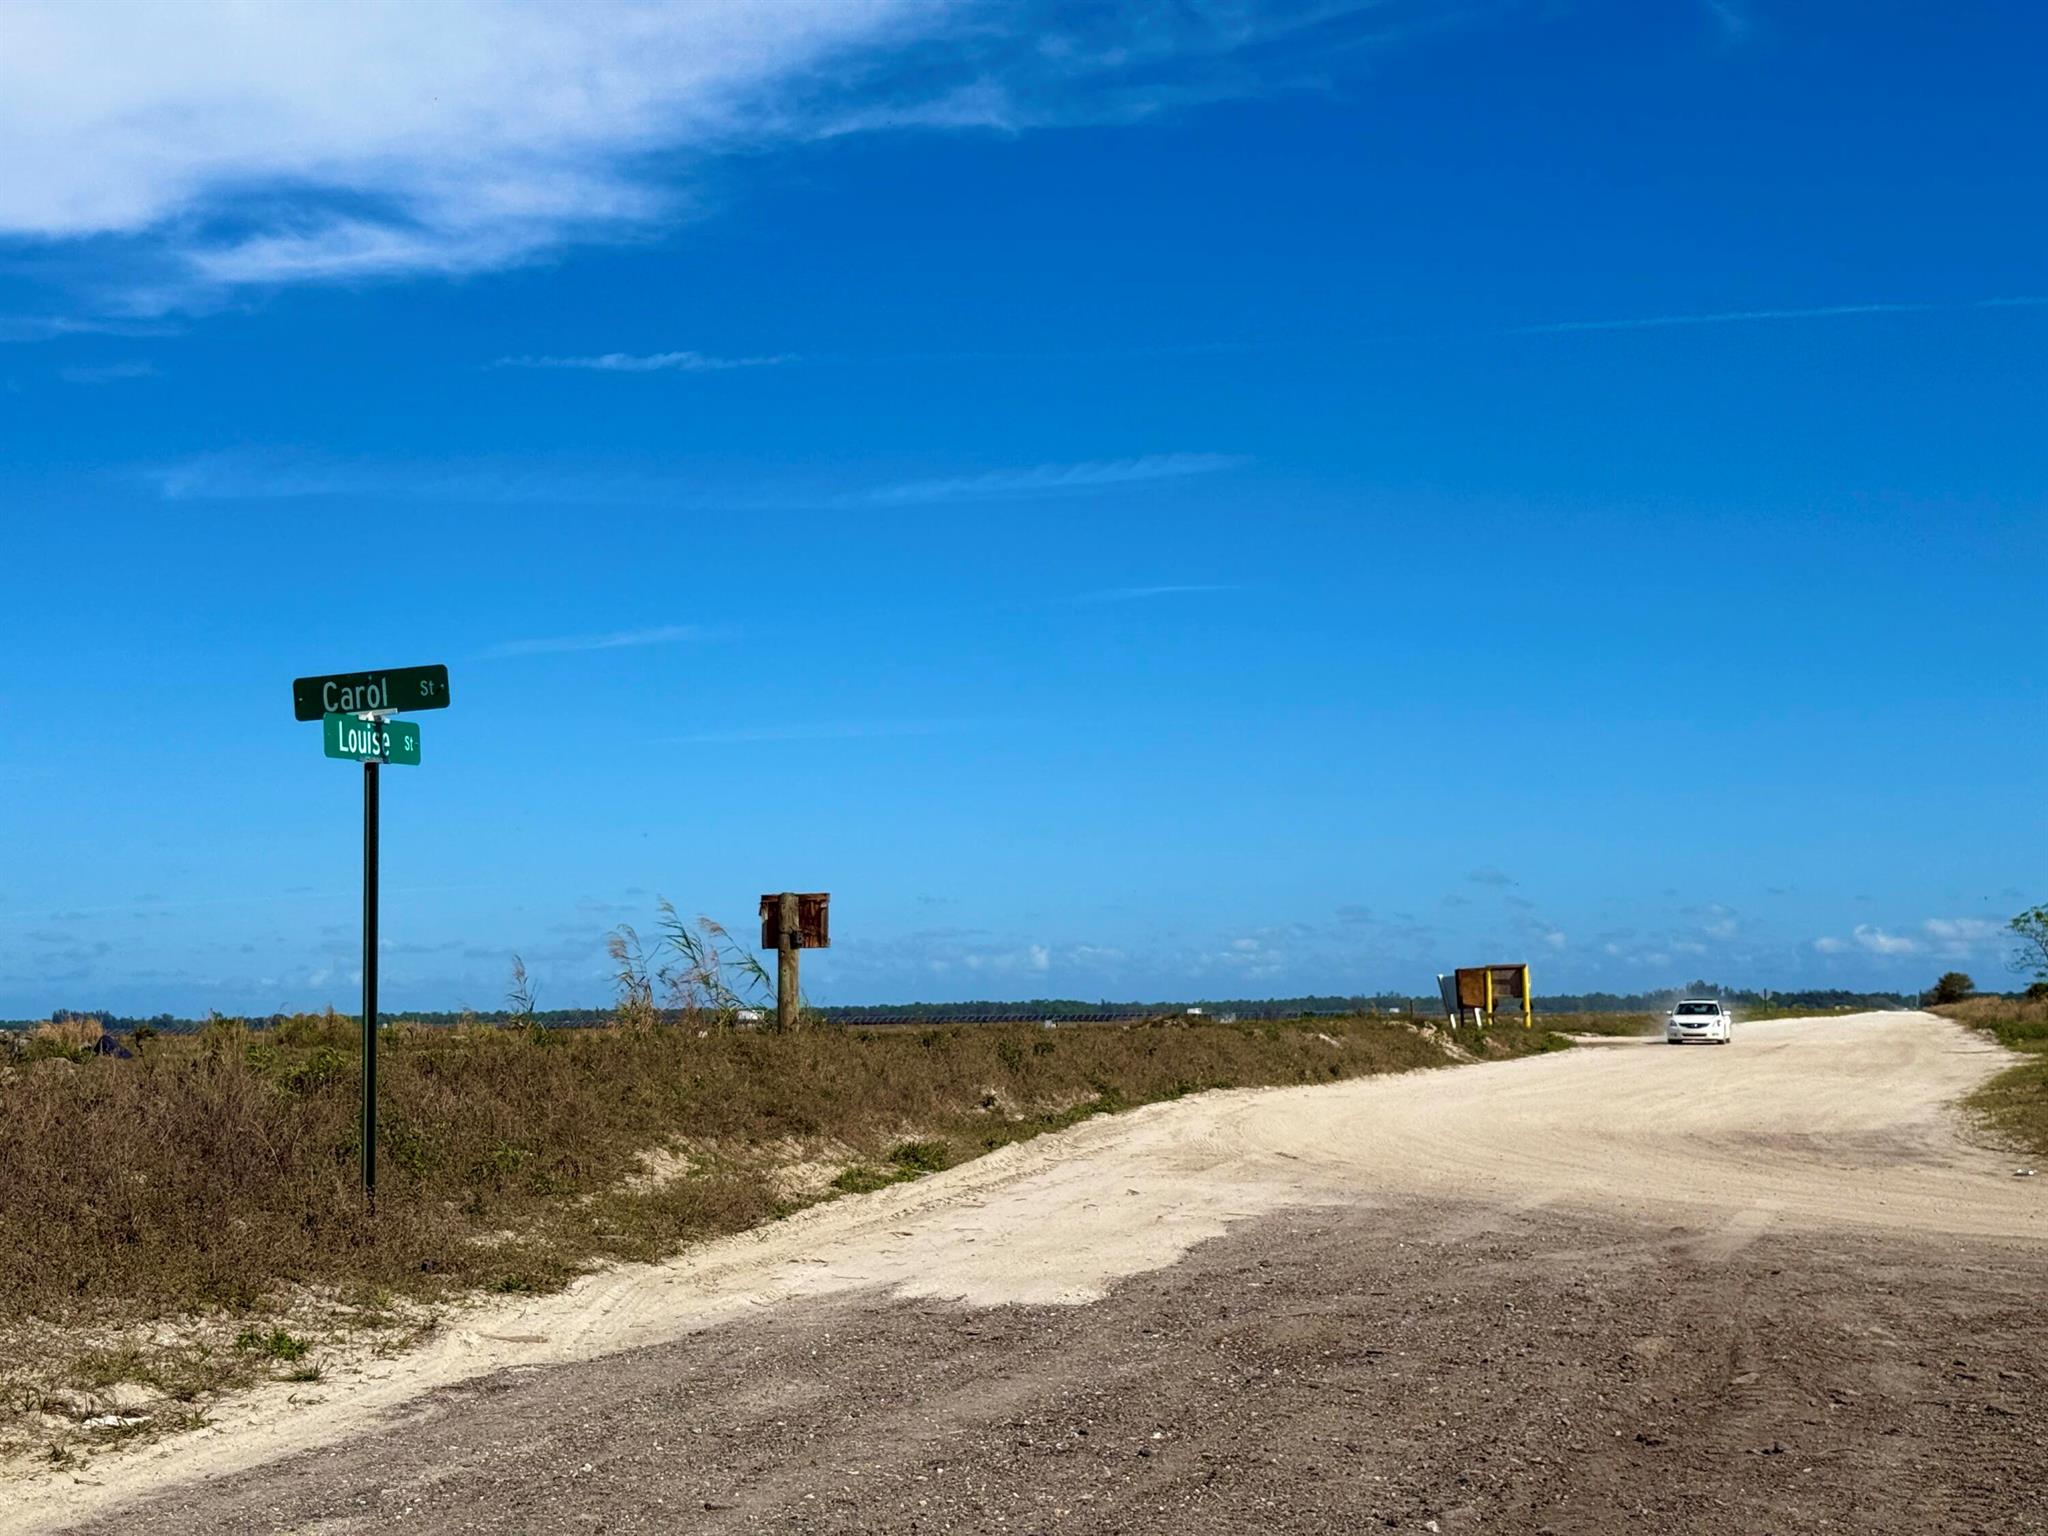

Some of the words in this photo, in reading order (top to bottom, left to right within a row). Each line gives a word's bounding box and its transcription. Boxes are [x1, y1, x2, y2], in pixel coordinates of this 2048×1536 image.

[323, 677, 388, 712] Carol
[420, 679, 435, 697] St
[338, 720, 391, 756] Louise
[404, 735, 414, 752] St
